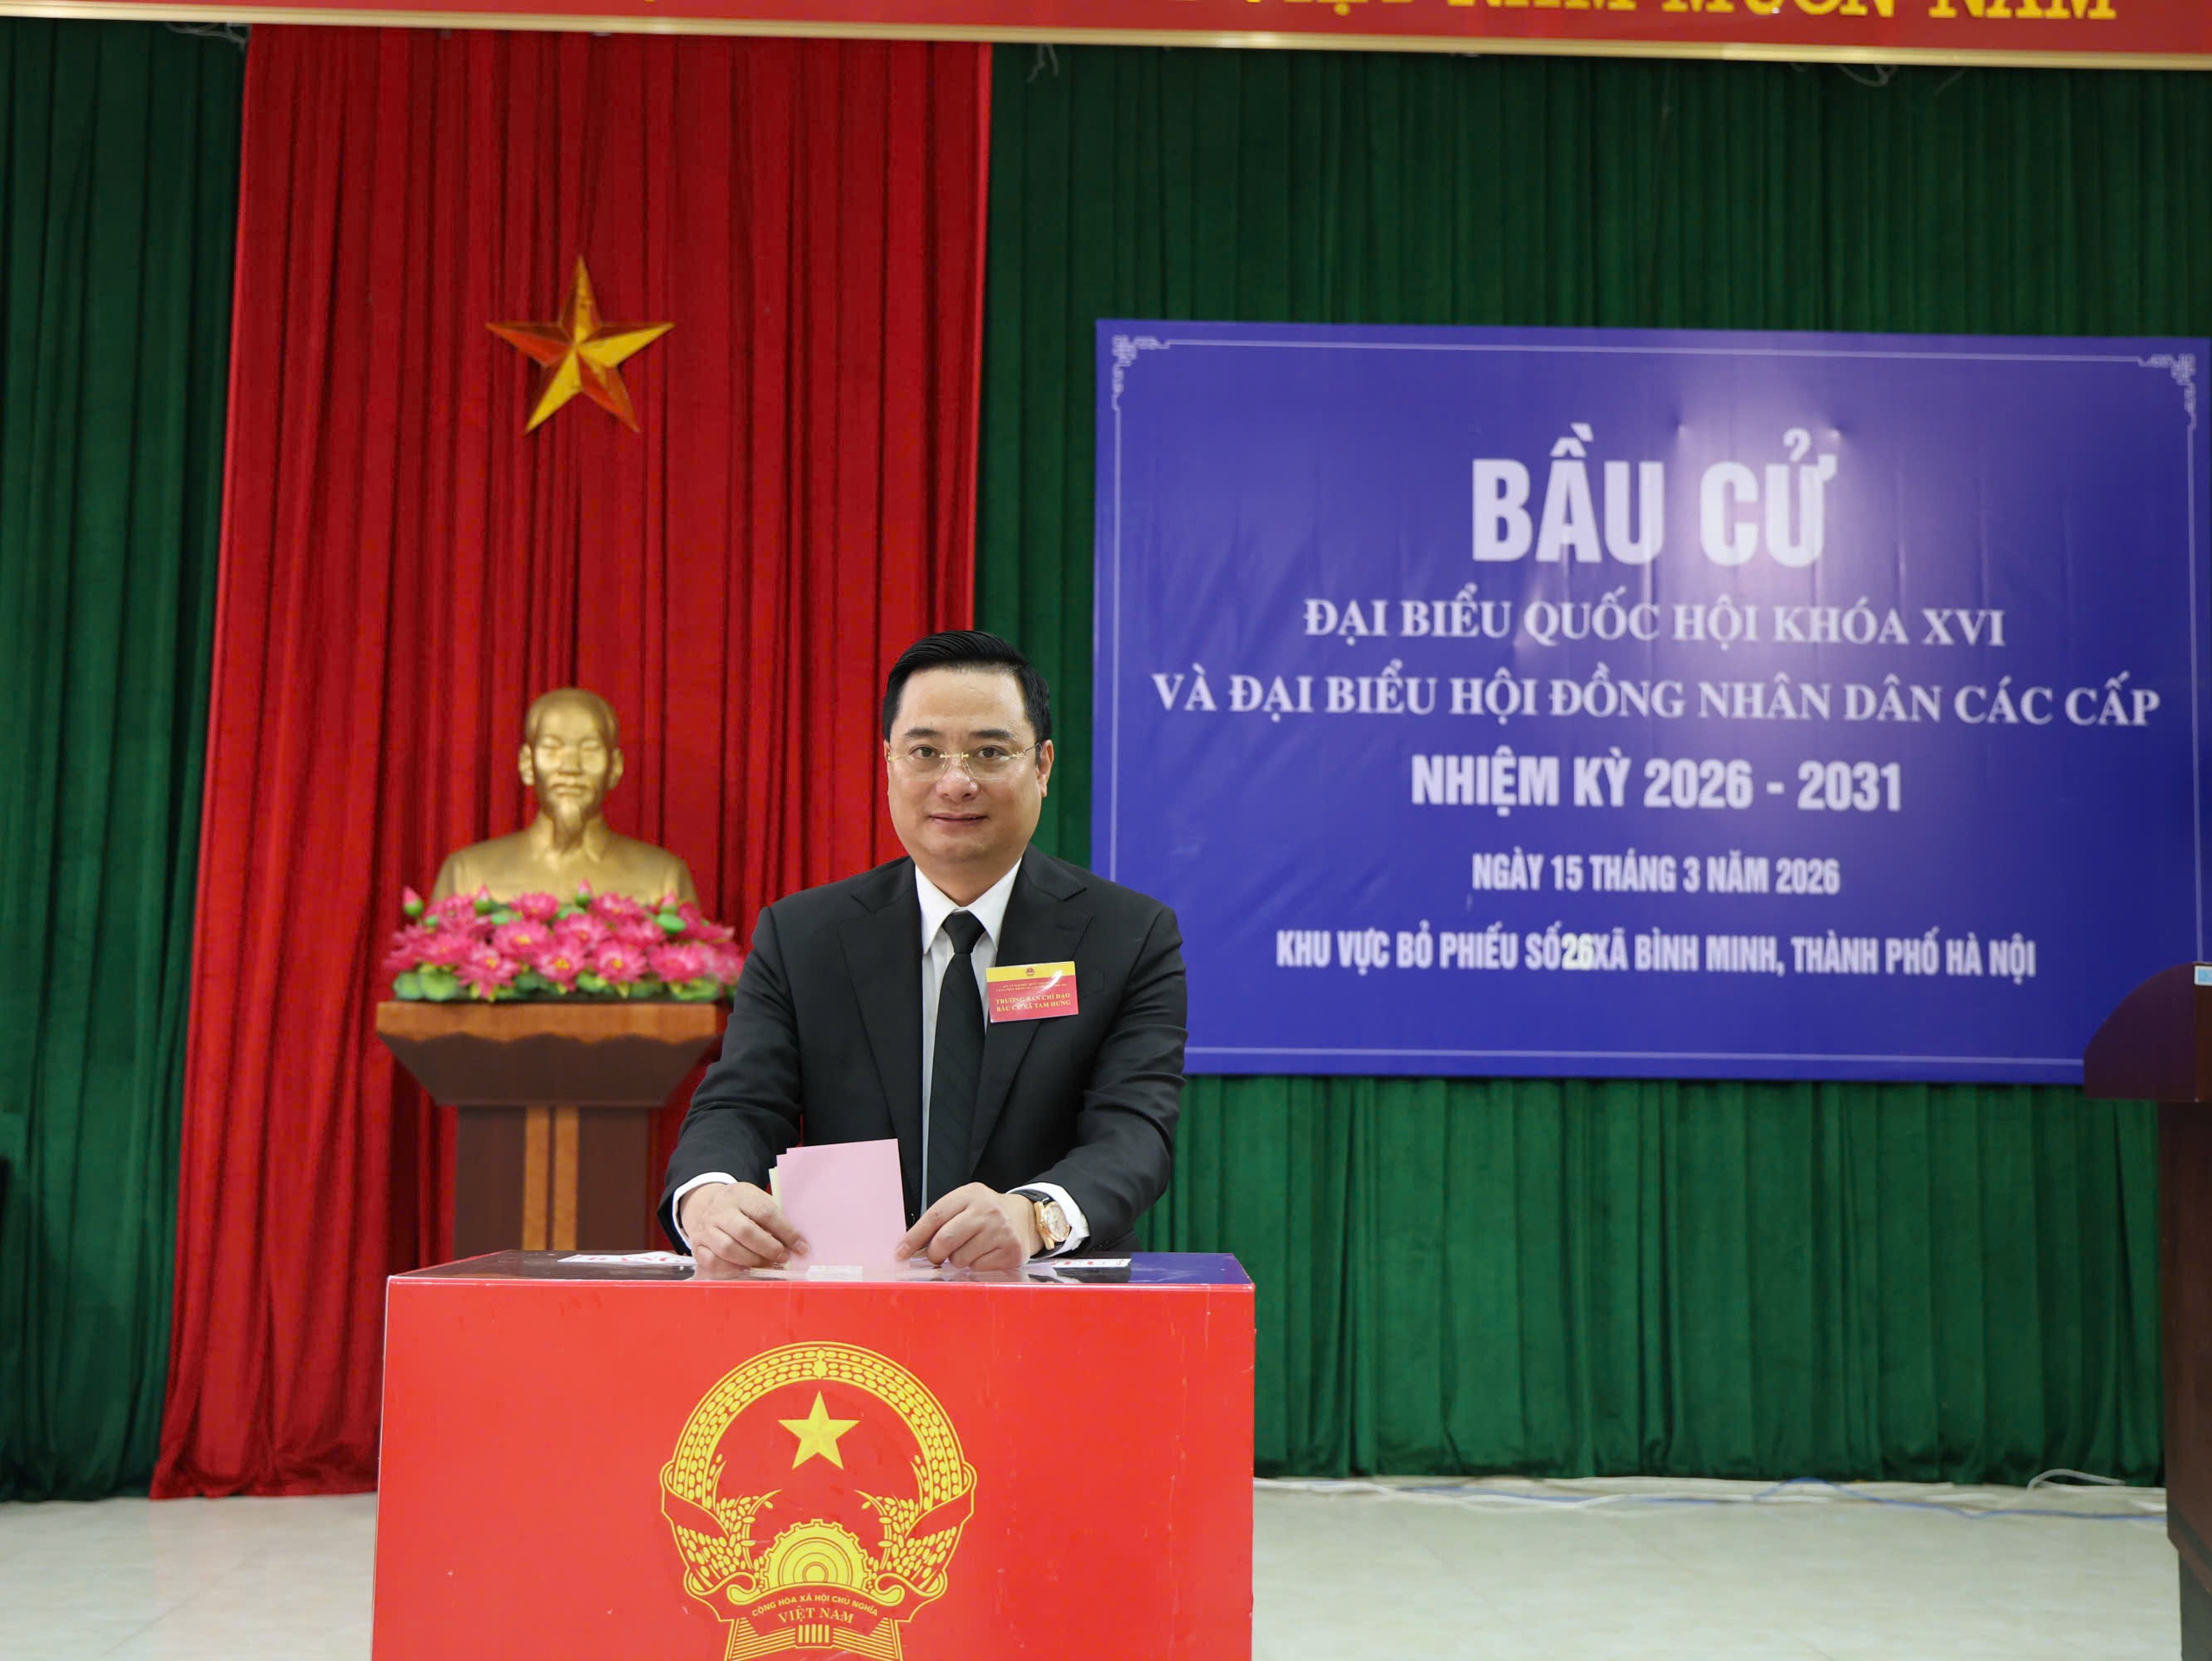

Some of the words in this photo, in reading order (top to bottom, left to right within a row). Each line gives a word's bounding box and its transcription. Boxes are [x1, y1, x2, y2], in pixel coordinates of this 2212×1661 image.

[1471, 422, 1665, 565] BẦU
[1699, 428, 1838, 568] CỬ
[1304, 598, 1388, 646] ĐẠI
[1401, 582, 1511, 639] BIỂU
[1523, 586, 1660, 646] QUỐC
[1672, 594, 1759, 652] HỘI
[1773, 596, 1910, 645] KHÓA
[1923, 608, 2005, 646] XVI
[1153, 662, 1217, 711] VÀ
[1230, 674, 1313, 722] ĐẠI
[1325, 659, 1438, 716] BIỂU
[1449, 666, 1538, 725] HỘI
[1548, 662, 1685, 718] ĐỒNG
[1697, 671, 1832, 720] NHÂN
[1843, 674, 1942, 722] DÂN
[1954, 675, 2053, 724] CÁC
[2064, 670, 2160, 727] CẤP
[1411, 744, 1560, 818] NHIỆM
[1573, 747, 1631, 807] KỲ
[1643, 758, 1753, 810] 2026
[1765, 780, 1785, 794] -
[1797, 760, 1901, 811] 2031
[1471, 846, 1544, 891] NGÀY
[1551, 855, 1584, 892] 15
[1588, 847, 1677, 893] THÁNG
[1682, 856, 1701, 894] 3
[1706, 850, 1769, 894] NĂM
[1775, 858, 1840, 895] 2026
[1276, 930, 1332, 968] KHU
[1337, 927, 1390, 976] VỰC
[1396, 920, 1433, 969] BỎ
[1439, 921, 1518, 970] PHIẾU
[1524, 920, 1562, 970] SỐ
[1560, 933, 1594, 970] 26
[1592, 927, 1629, 971] XÃ
[1635, 927, 1699, 971] BÌNH
[1705, 933, 1785, 977] MINH,
[1791, 929, 1878, 975] THÀNH
[1885, 926, 1940, 976] PHỐ
[1946, 931, 1983, 977] HÀ
[1989, 932, 2036, 985] NỘI
[751, 1601, 777, 1617] CỘNG
[778, 1596, 798, 1607] HÒA
[778, 1605, 816, 1623] VIỆT
[819, 1607, 855, 1624] NAM
